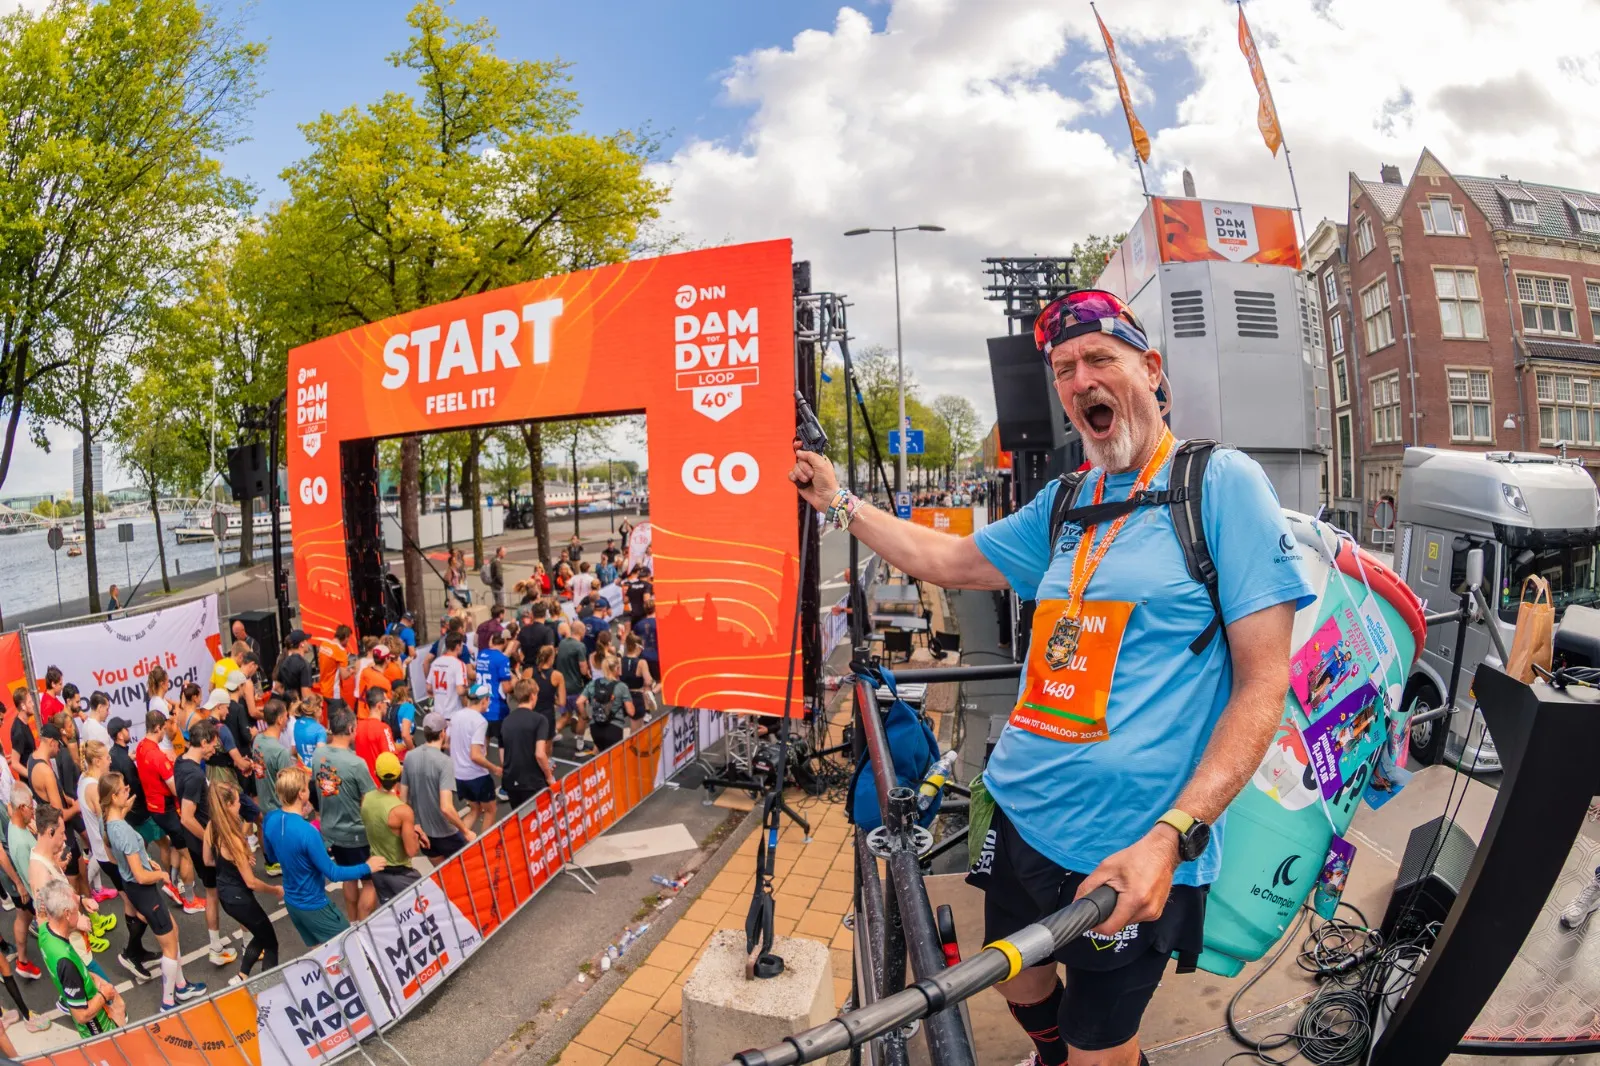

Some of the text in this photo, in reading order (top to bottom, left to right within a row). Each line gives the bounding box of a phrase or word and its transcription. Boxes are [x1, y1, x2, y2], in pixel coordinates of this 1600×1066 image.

[1215, 217, 1245, 229] DAM
[1217, 227, 1247, 239] DAM
[700, 285, 726, 301] NN
[675, 307, 758, 342] DAM
[381, 298, 564, 390] START
[675, 336, 759, 370] DAM
[699, 372, 735, 385] LOOP
[297, 382, 328, 406] DAM
[426, 387, 495, 415] FEEL IT!
[297, 402, 328, 424] DAM
[682, 451, 760, 495] GO
[300, 476, 328, 505] GO
[1346, 629, 1364, 657] FEVER
[1351, 621, 1375, 663] FESTIVAL
[92, 651, 178, 687] You did it
[168, 667, 198, 691] ood!
[433, 671, 447, 691] 14
[1042, 679, 1075, 700] 1480
[1040, 722, 1078, 738] DAMLOOP
[1311, 741, 1325, 771] Party
[1318, 733, 1338, 781] Playground
[1250, 884, 1261, 896] le
